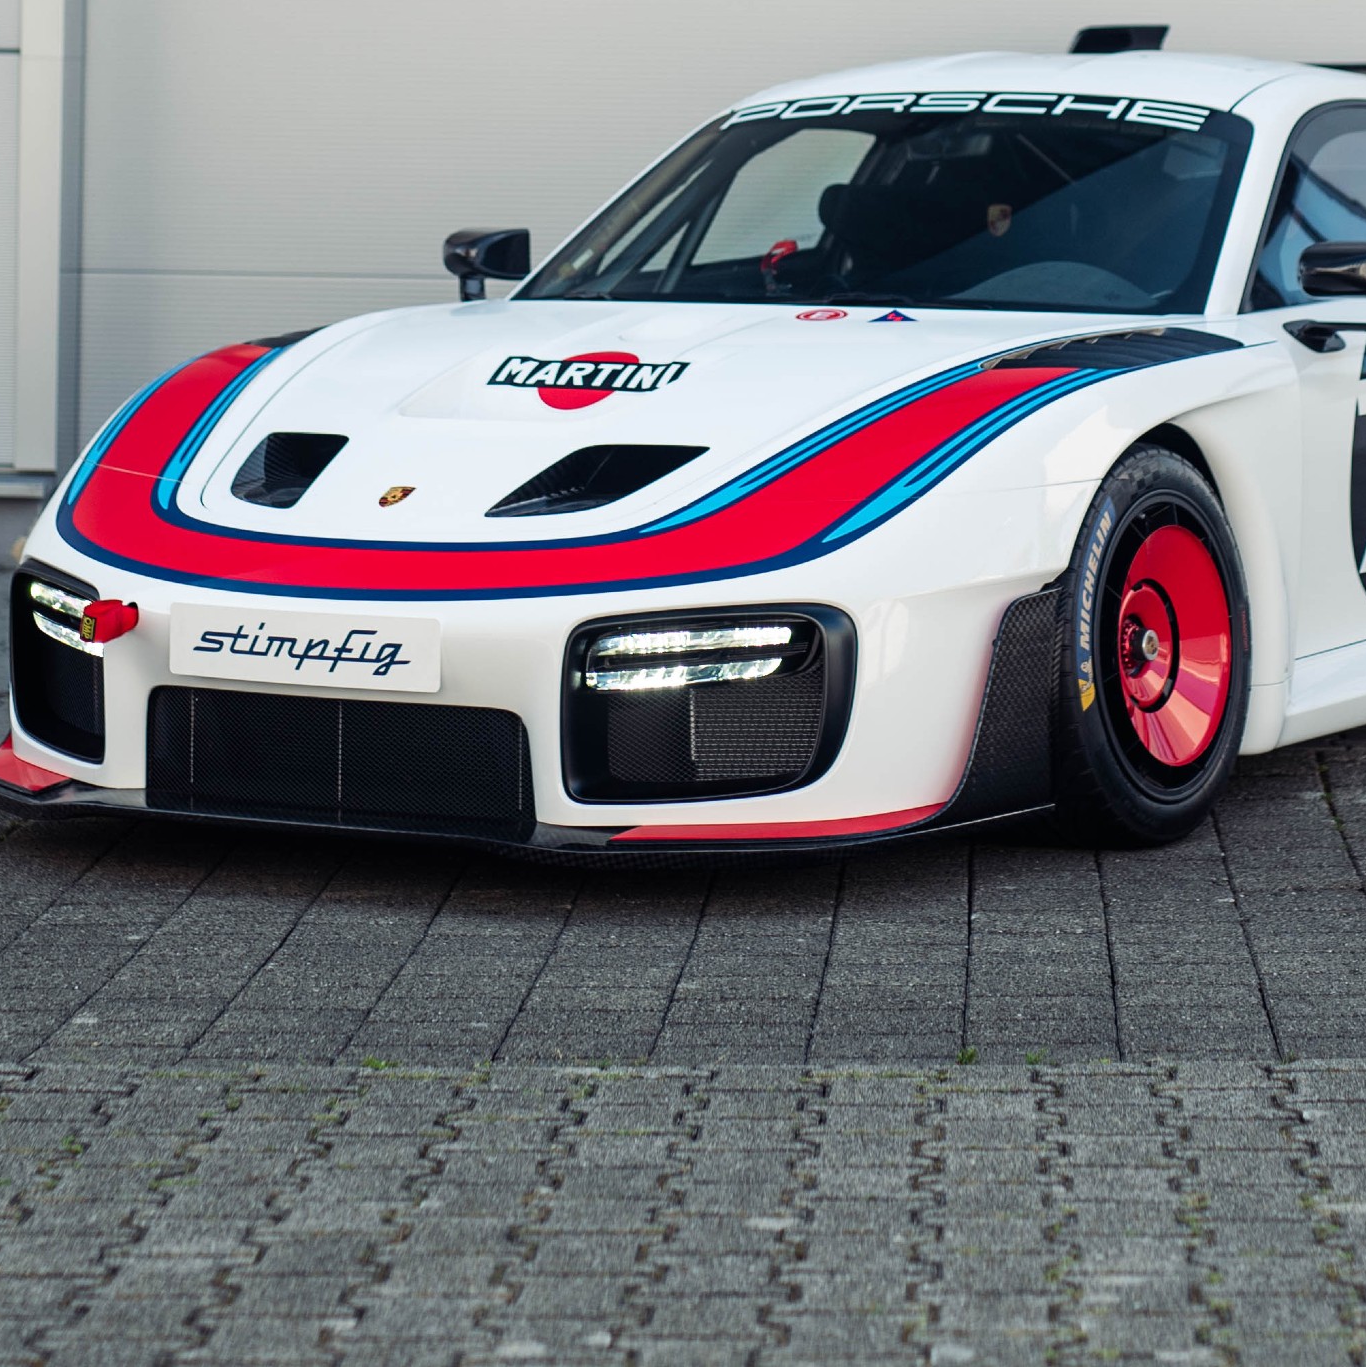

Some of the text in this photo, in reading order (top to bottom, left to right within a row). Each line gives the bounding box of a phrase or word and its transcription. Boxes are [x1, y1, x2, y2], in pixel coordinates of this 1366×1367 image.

[720, 92, 1210, 132] PORSCHE
[494, 357, 681, 389] MARTINI
[1080, 510, 1113, 651] MICHELIN
[84, 617, 92, 640] OMP
[193, 622, 411, 676] stimpfig
